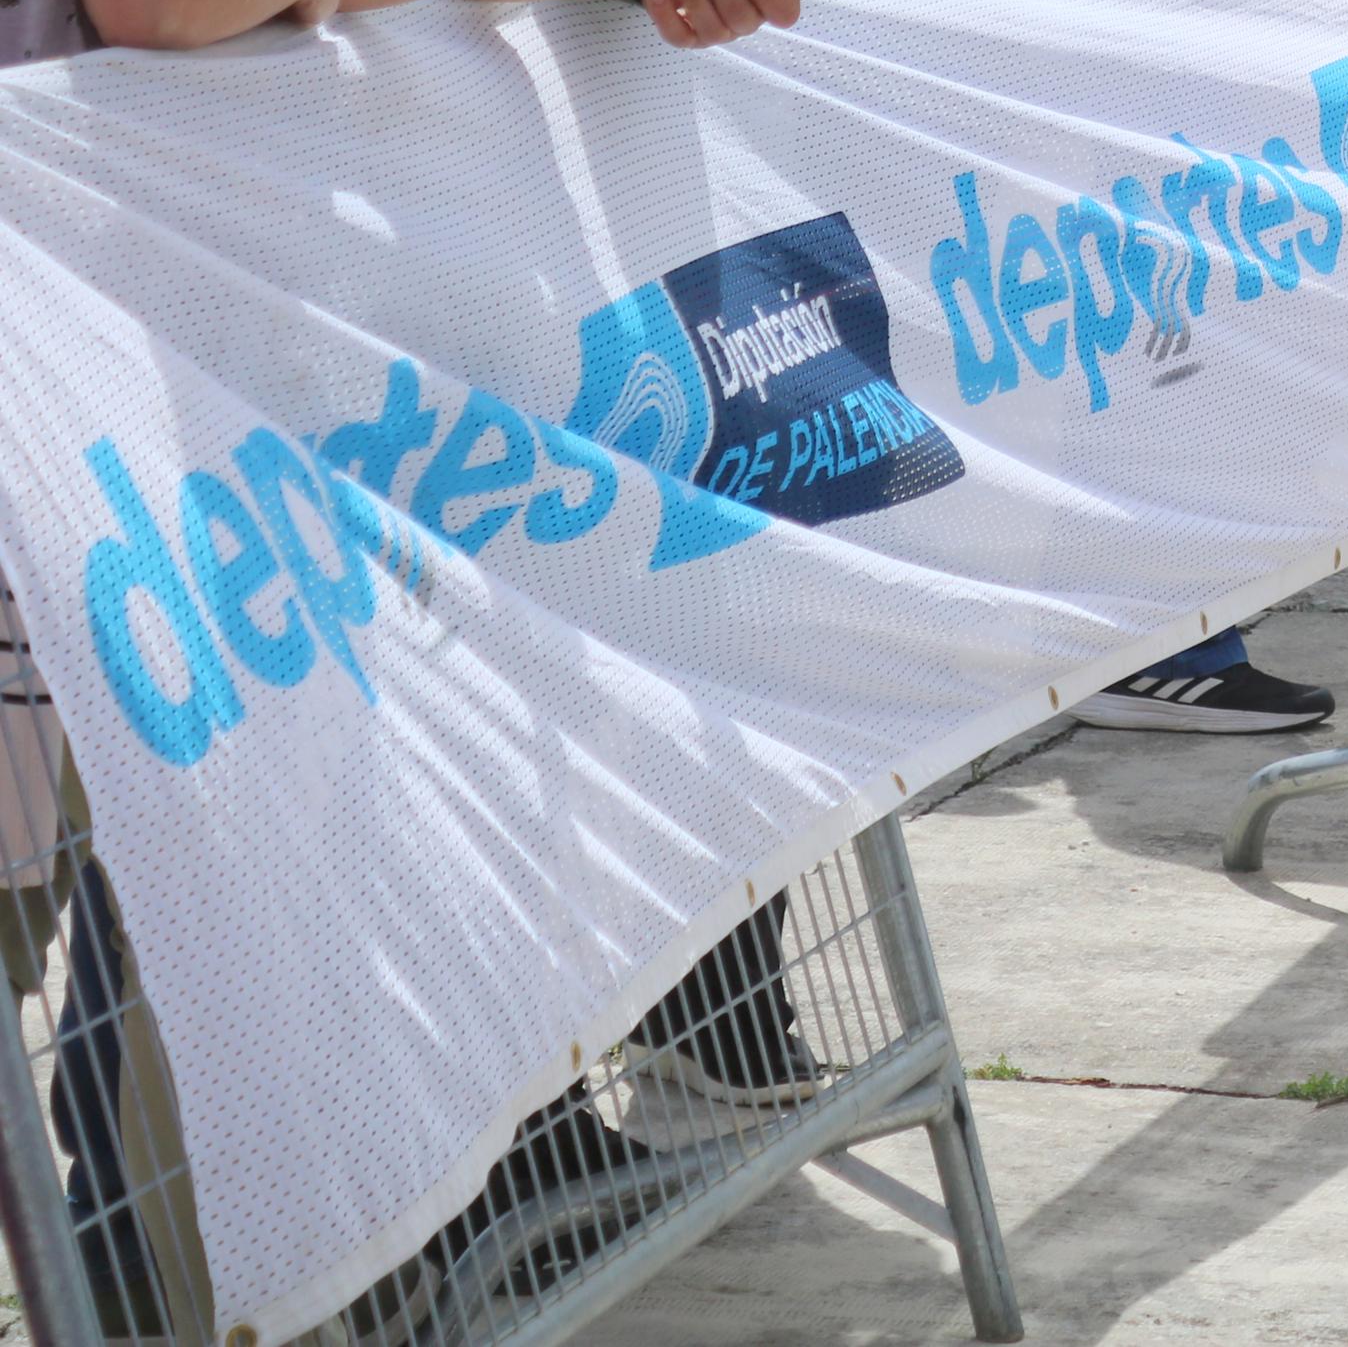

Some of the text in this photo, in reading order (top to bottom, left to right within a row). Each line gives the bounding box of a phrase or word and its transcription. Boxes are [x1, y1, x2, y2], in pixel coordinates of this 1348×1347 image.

[697, 282, 842, 403] Diputación
[929, 132, 1343, 413] deportes
[83, 356, 618, 768] deptes
[707, 431, 777, 503] DE
